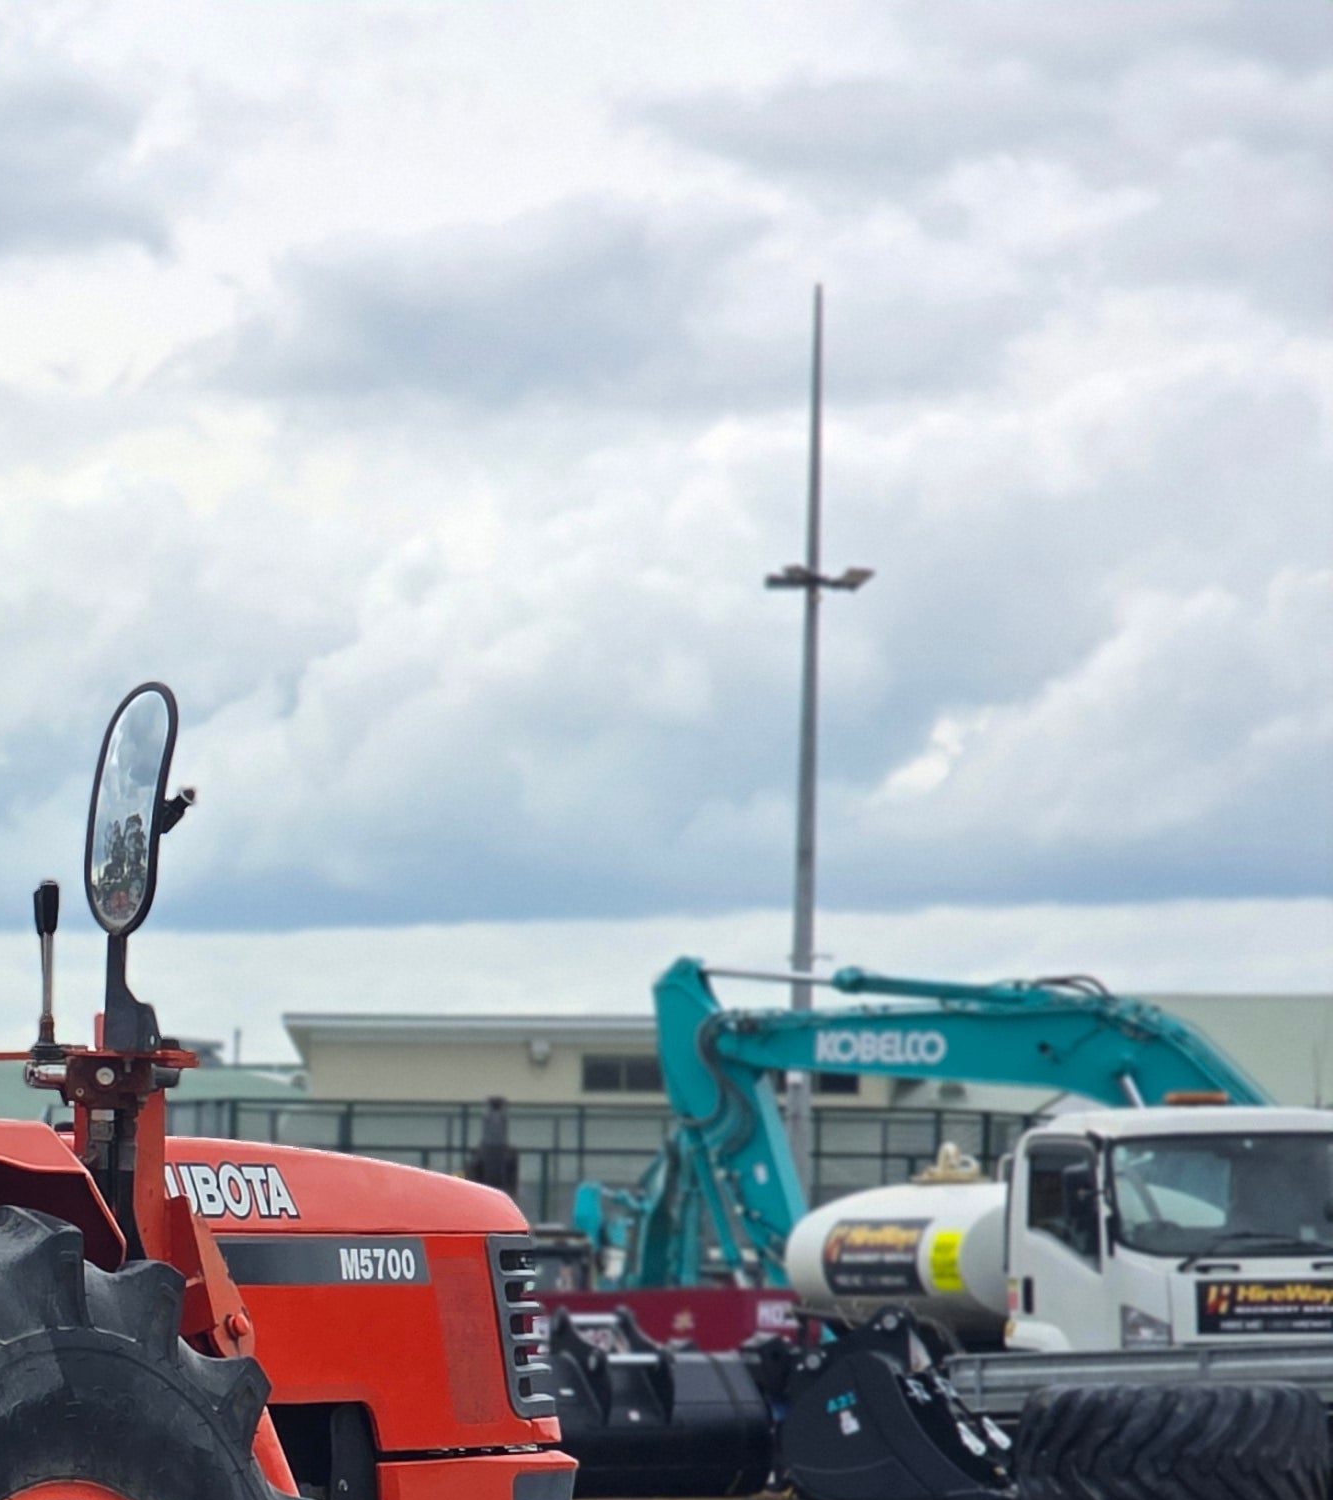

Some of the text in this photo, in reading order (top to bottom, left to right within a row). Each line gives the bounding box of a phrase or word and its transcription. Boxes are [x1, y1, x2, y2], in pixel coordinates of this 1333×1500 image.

[815, 1029, 947, 1065] KOBELCO
[164, 1161, 301, 1219] UBOTA
[339, 1247, 416, 1281] M5700
[1236, 1284, 1333, 1305] HireWay
